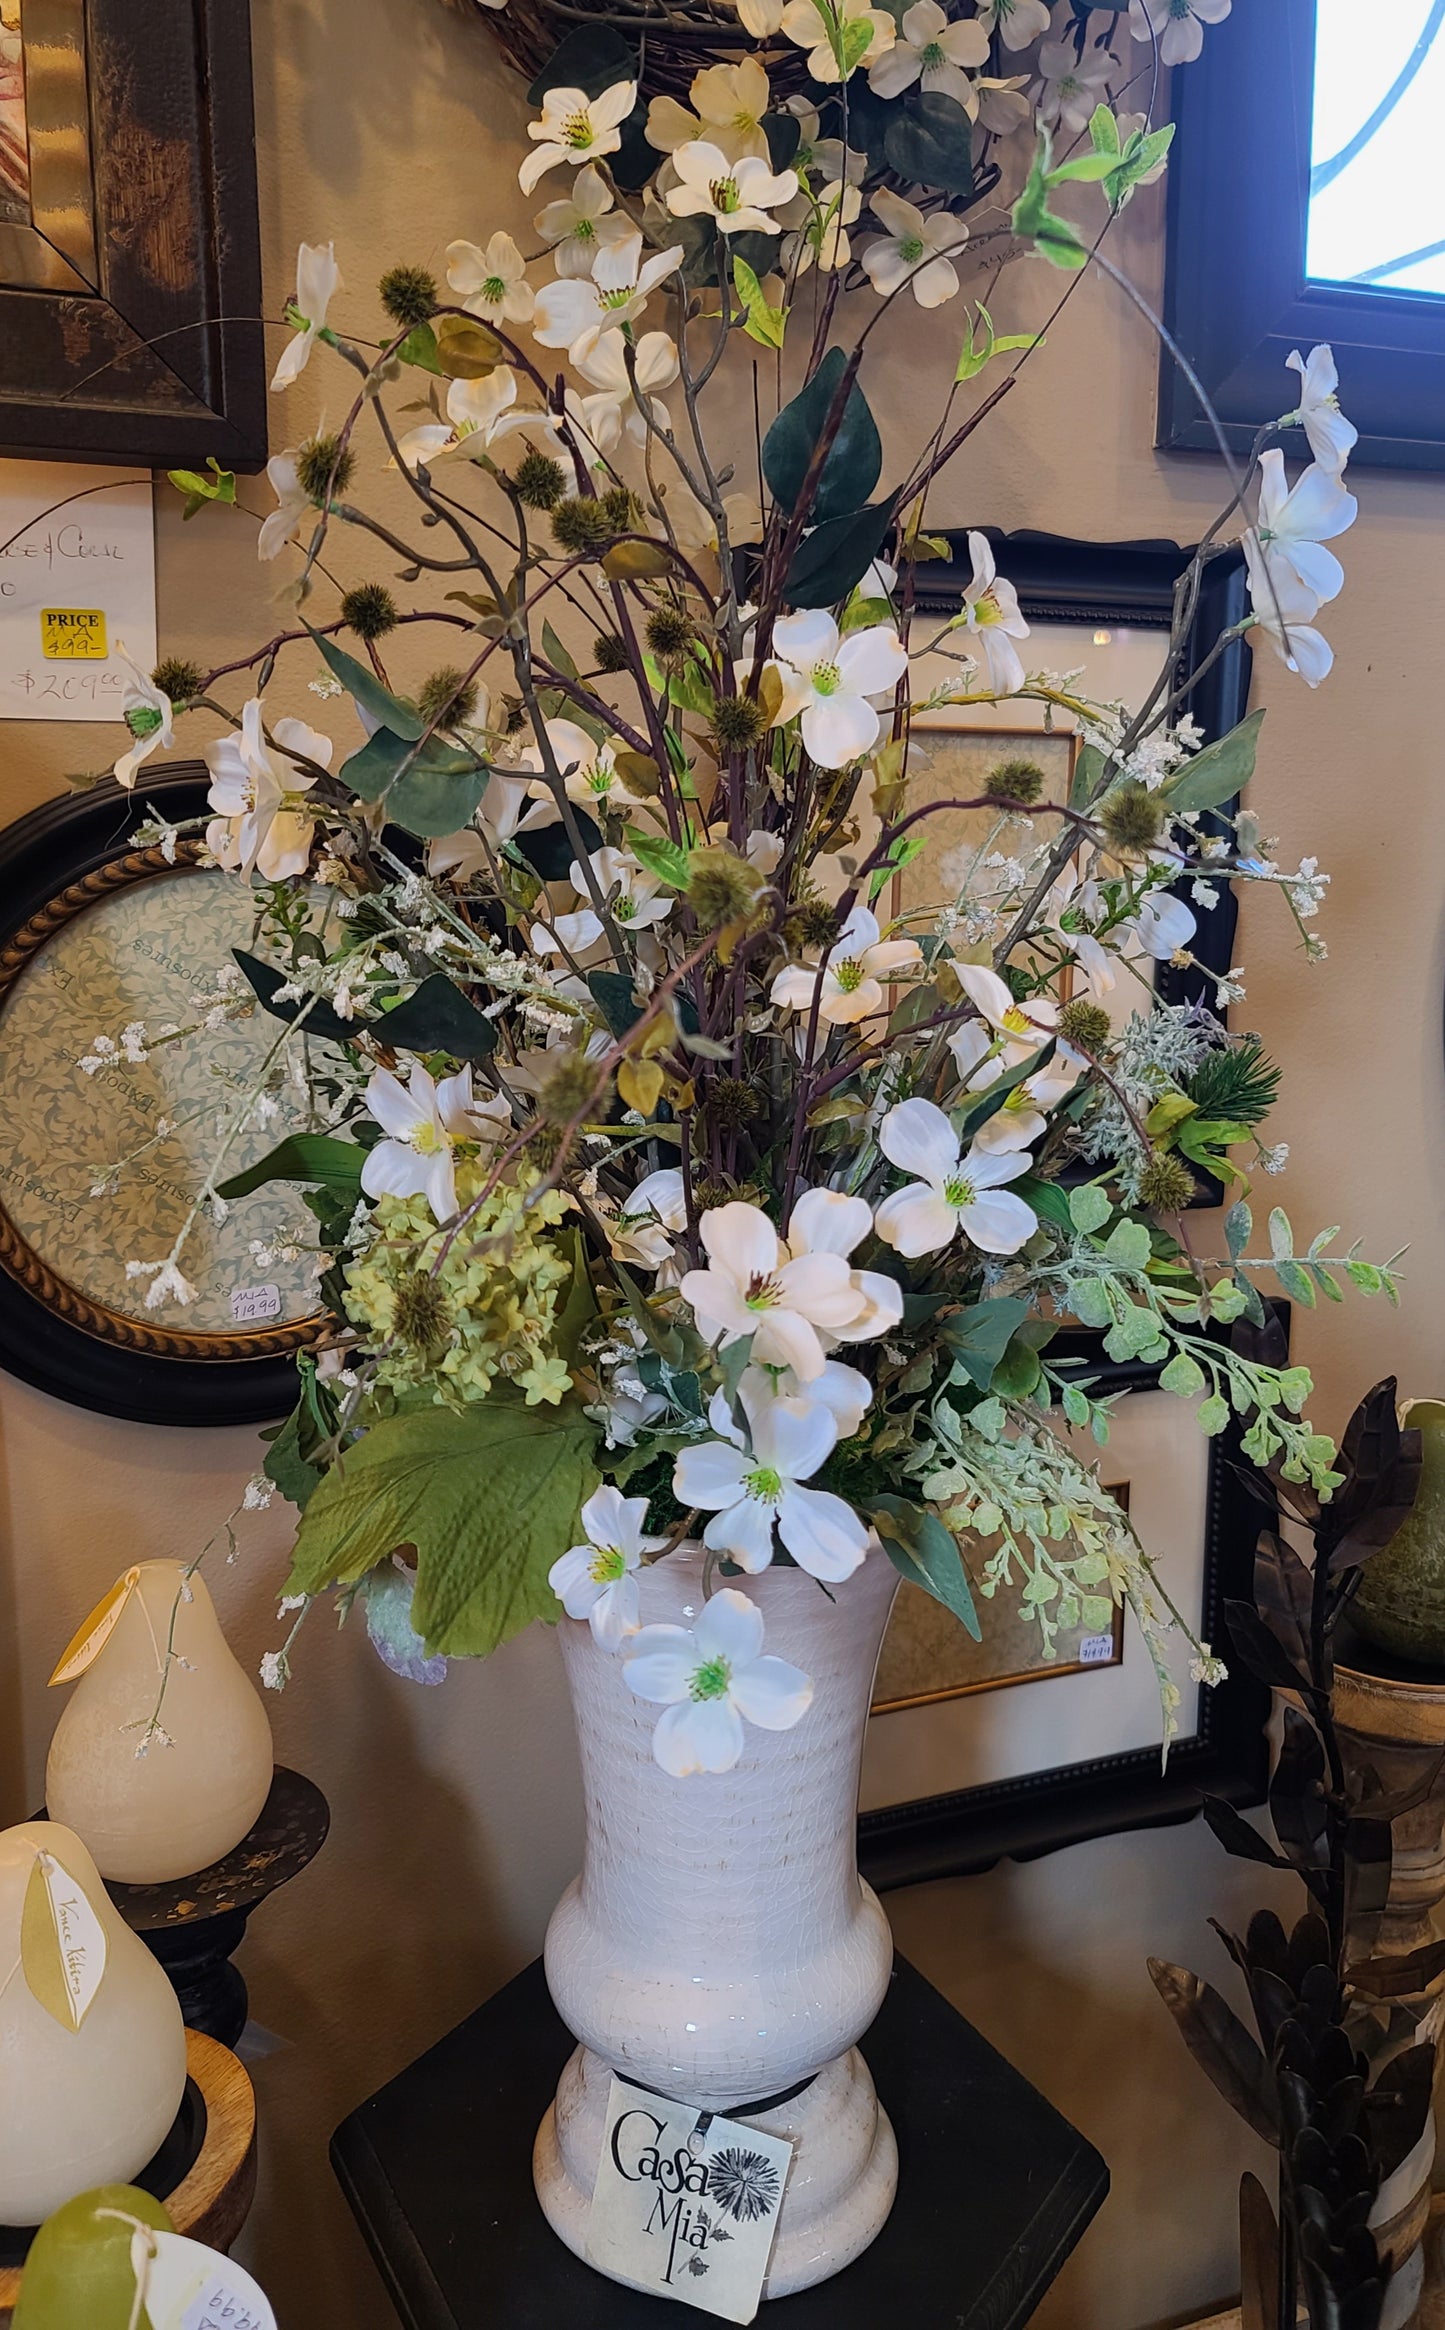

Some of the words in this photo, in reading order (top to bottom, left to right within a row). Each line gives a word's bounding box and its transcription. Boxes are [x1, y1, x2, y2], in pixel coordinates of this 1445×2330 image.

[47, 613, 100, 627] PRICE
[133, 939, 217, 994] xposures
[58, 1897, 80, 1945] Vance
[641, 2186, 709, 2286] Mia
